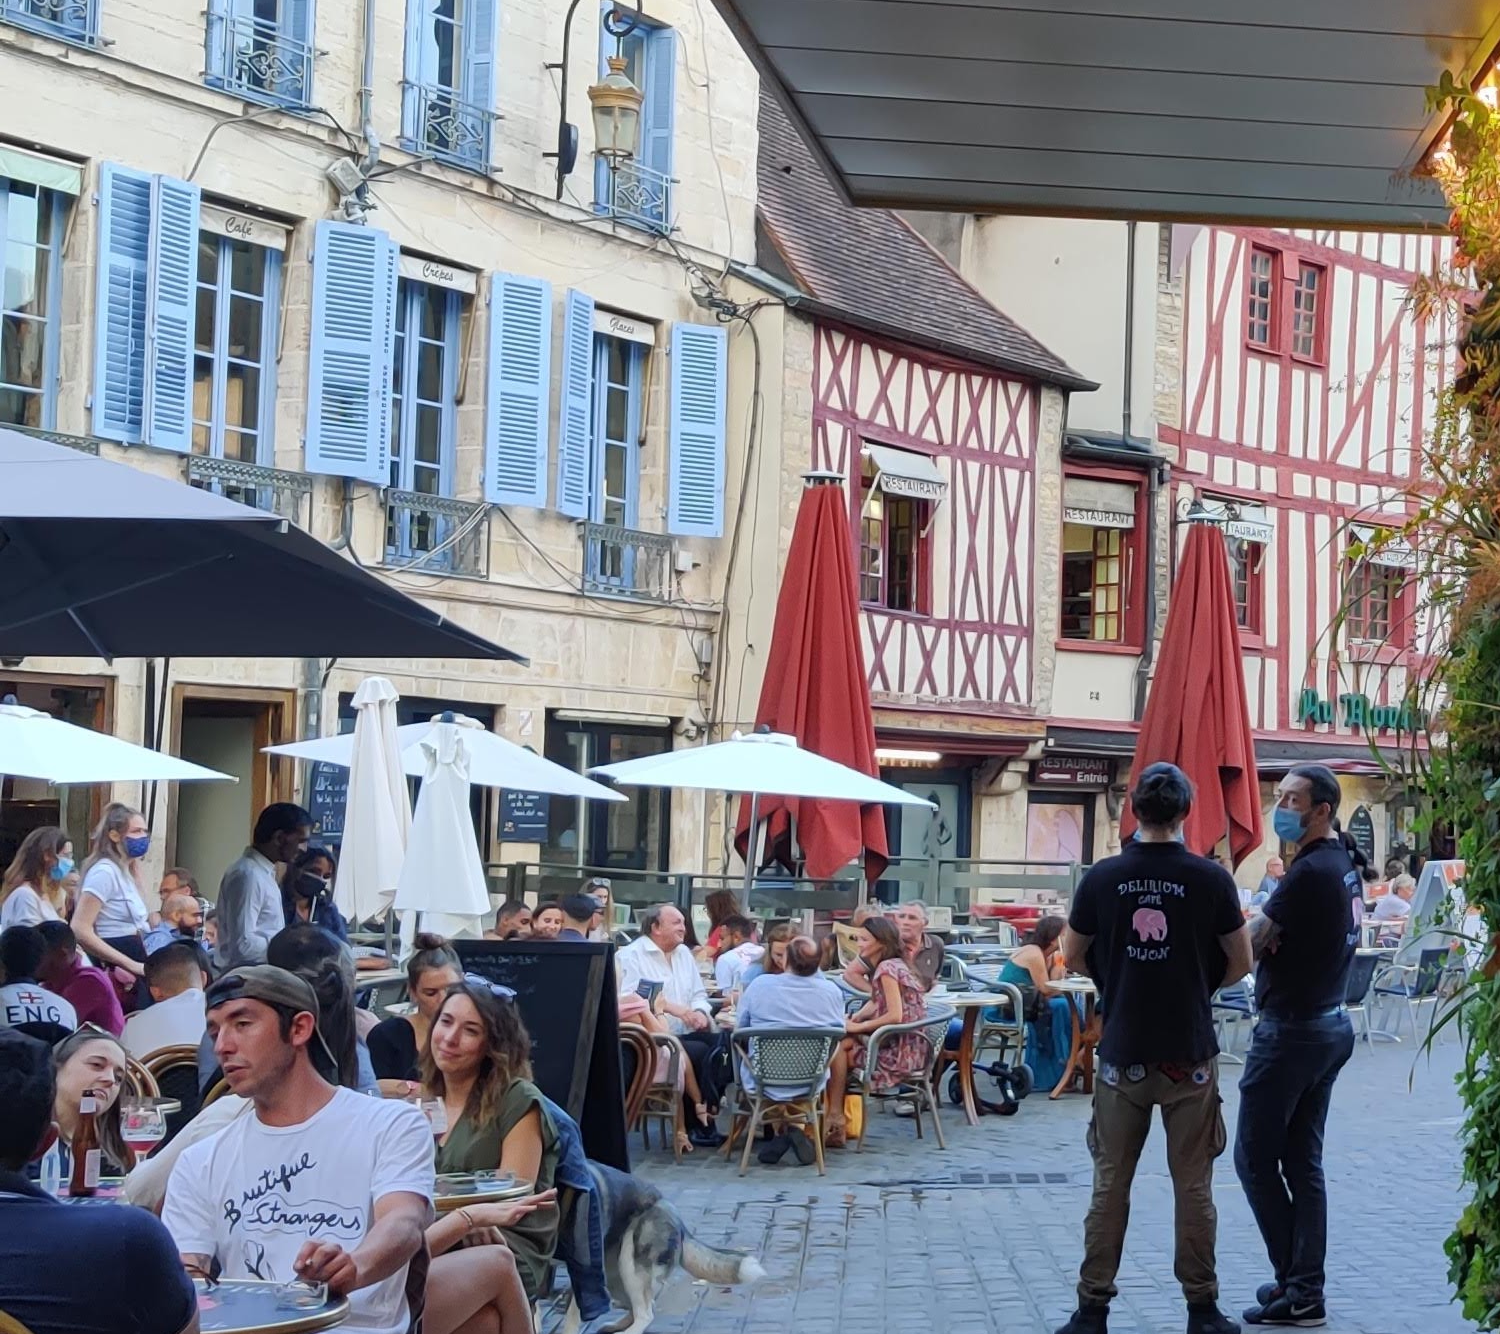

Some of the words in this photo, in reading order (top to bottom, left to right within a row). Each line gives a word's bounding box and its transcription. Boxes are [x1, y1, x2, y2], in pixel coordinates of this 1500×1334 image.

[225, 216, 253, 238] Café
[886, 476, 942, 496] RESTAURANT
[1064, 508, 1129, 524] RESTAURANT
[1220, 524, 1267, 539] TAURANT
[1039, 757, 1109, 770] RESTAURANT
[1076, 770, 1109, 784] Entrée
[1117, 879, 1185, 897] DELIRIUM
[1126, 945, 1171, 961] DIJON
[6, 1005, 61, 1024] ENG
[246, 1200, 361, 1237] Strangers
